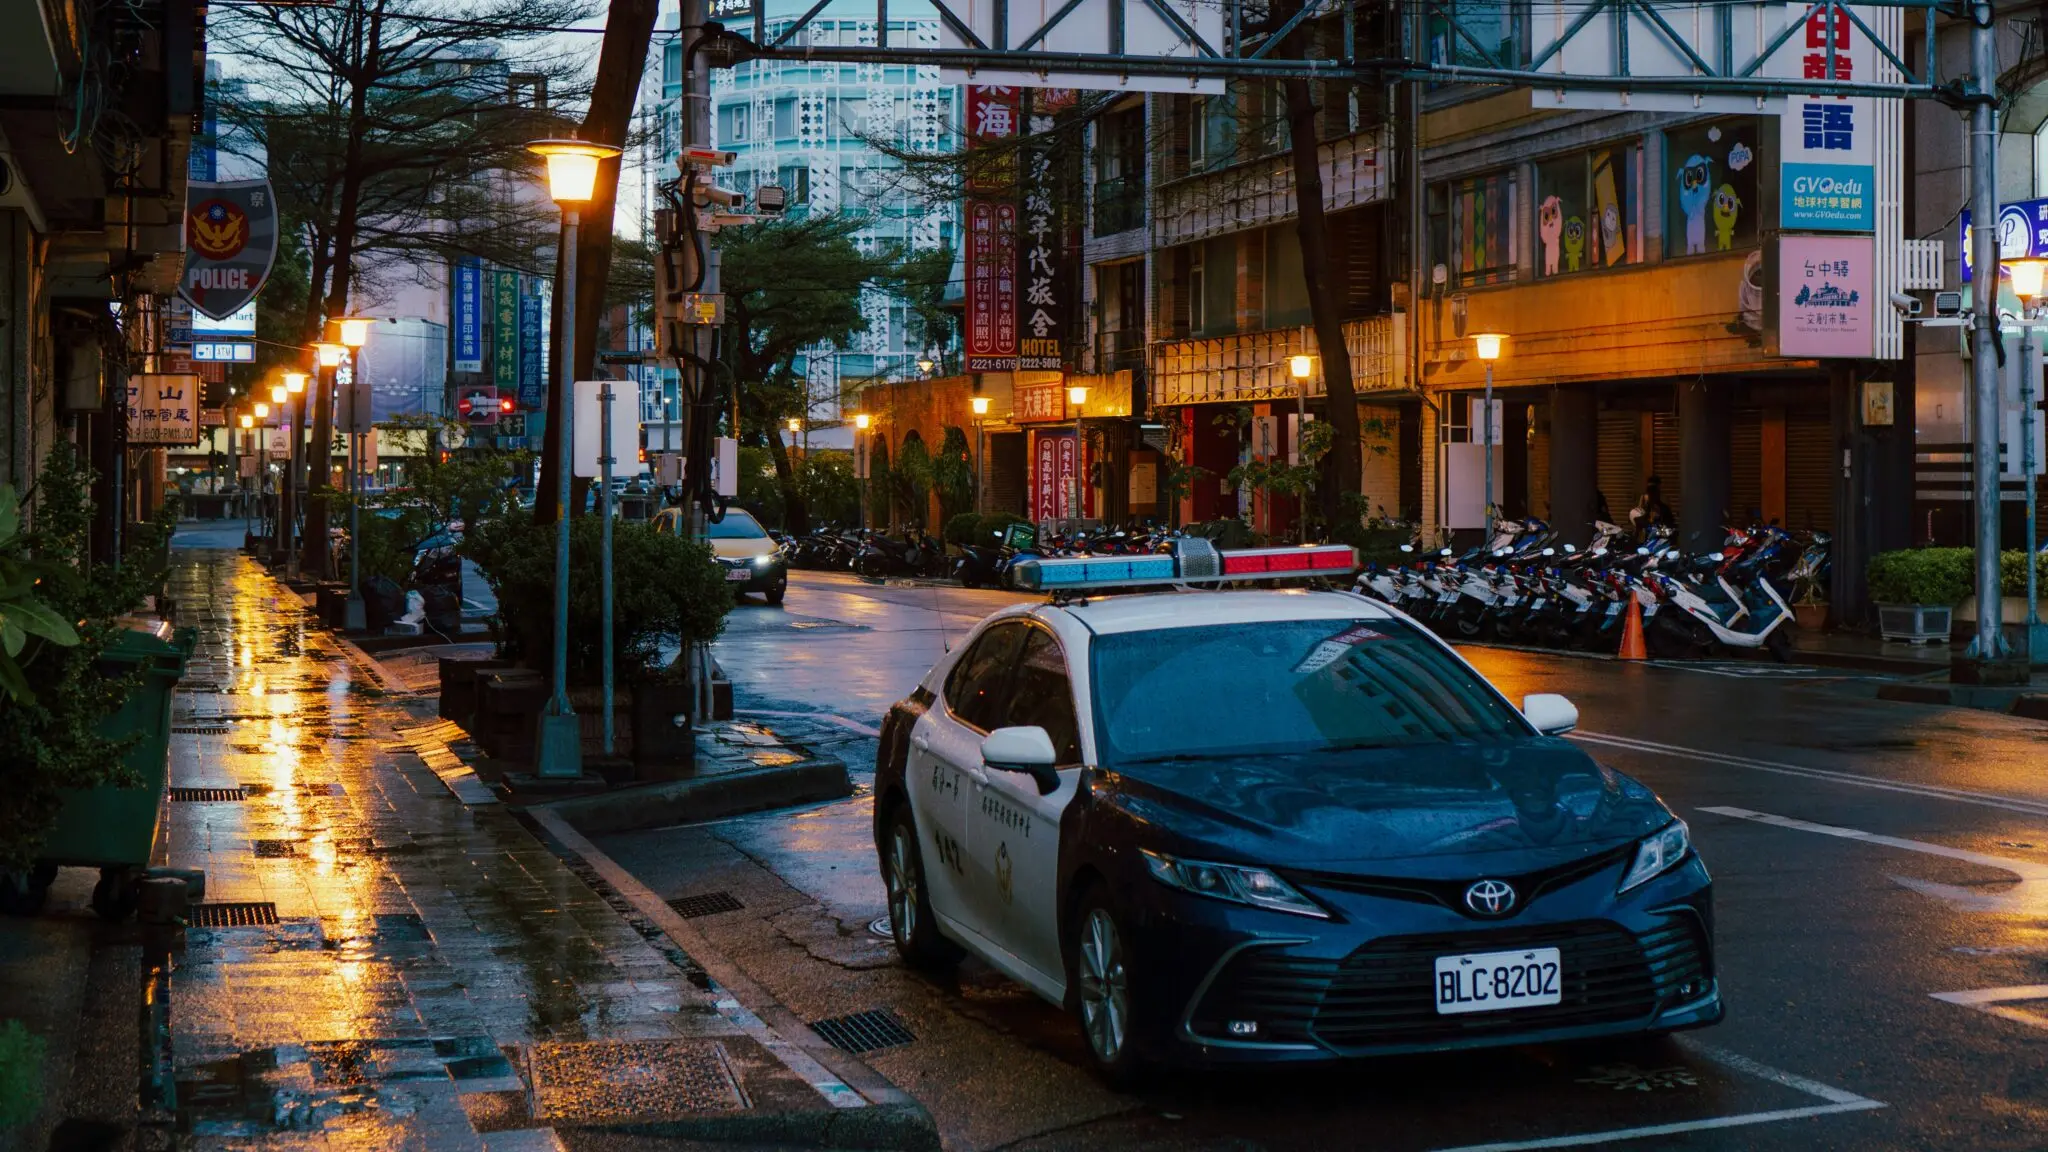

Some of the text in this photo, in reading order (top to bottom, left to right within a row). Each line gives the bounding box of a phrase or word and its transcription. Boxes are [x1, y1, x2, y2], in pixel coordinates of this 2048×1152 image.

[1793, 176, 1862, 195] GVOedu
[1794, 196, 1862, 208] 地球村學習網
[188, 268, 249, 290] POLICE
[1021, 339, 1061, 356] HOTEL
